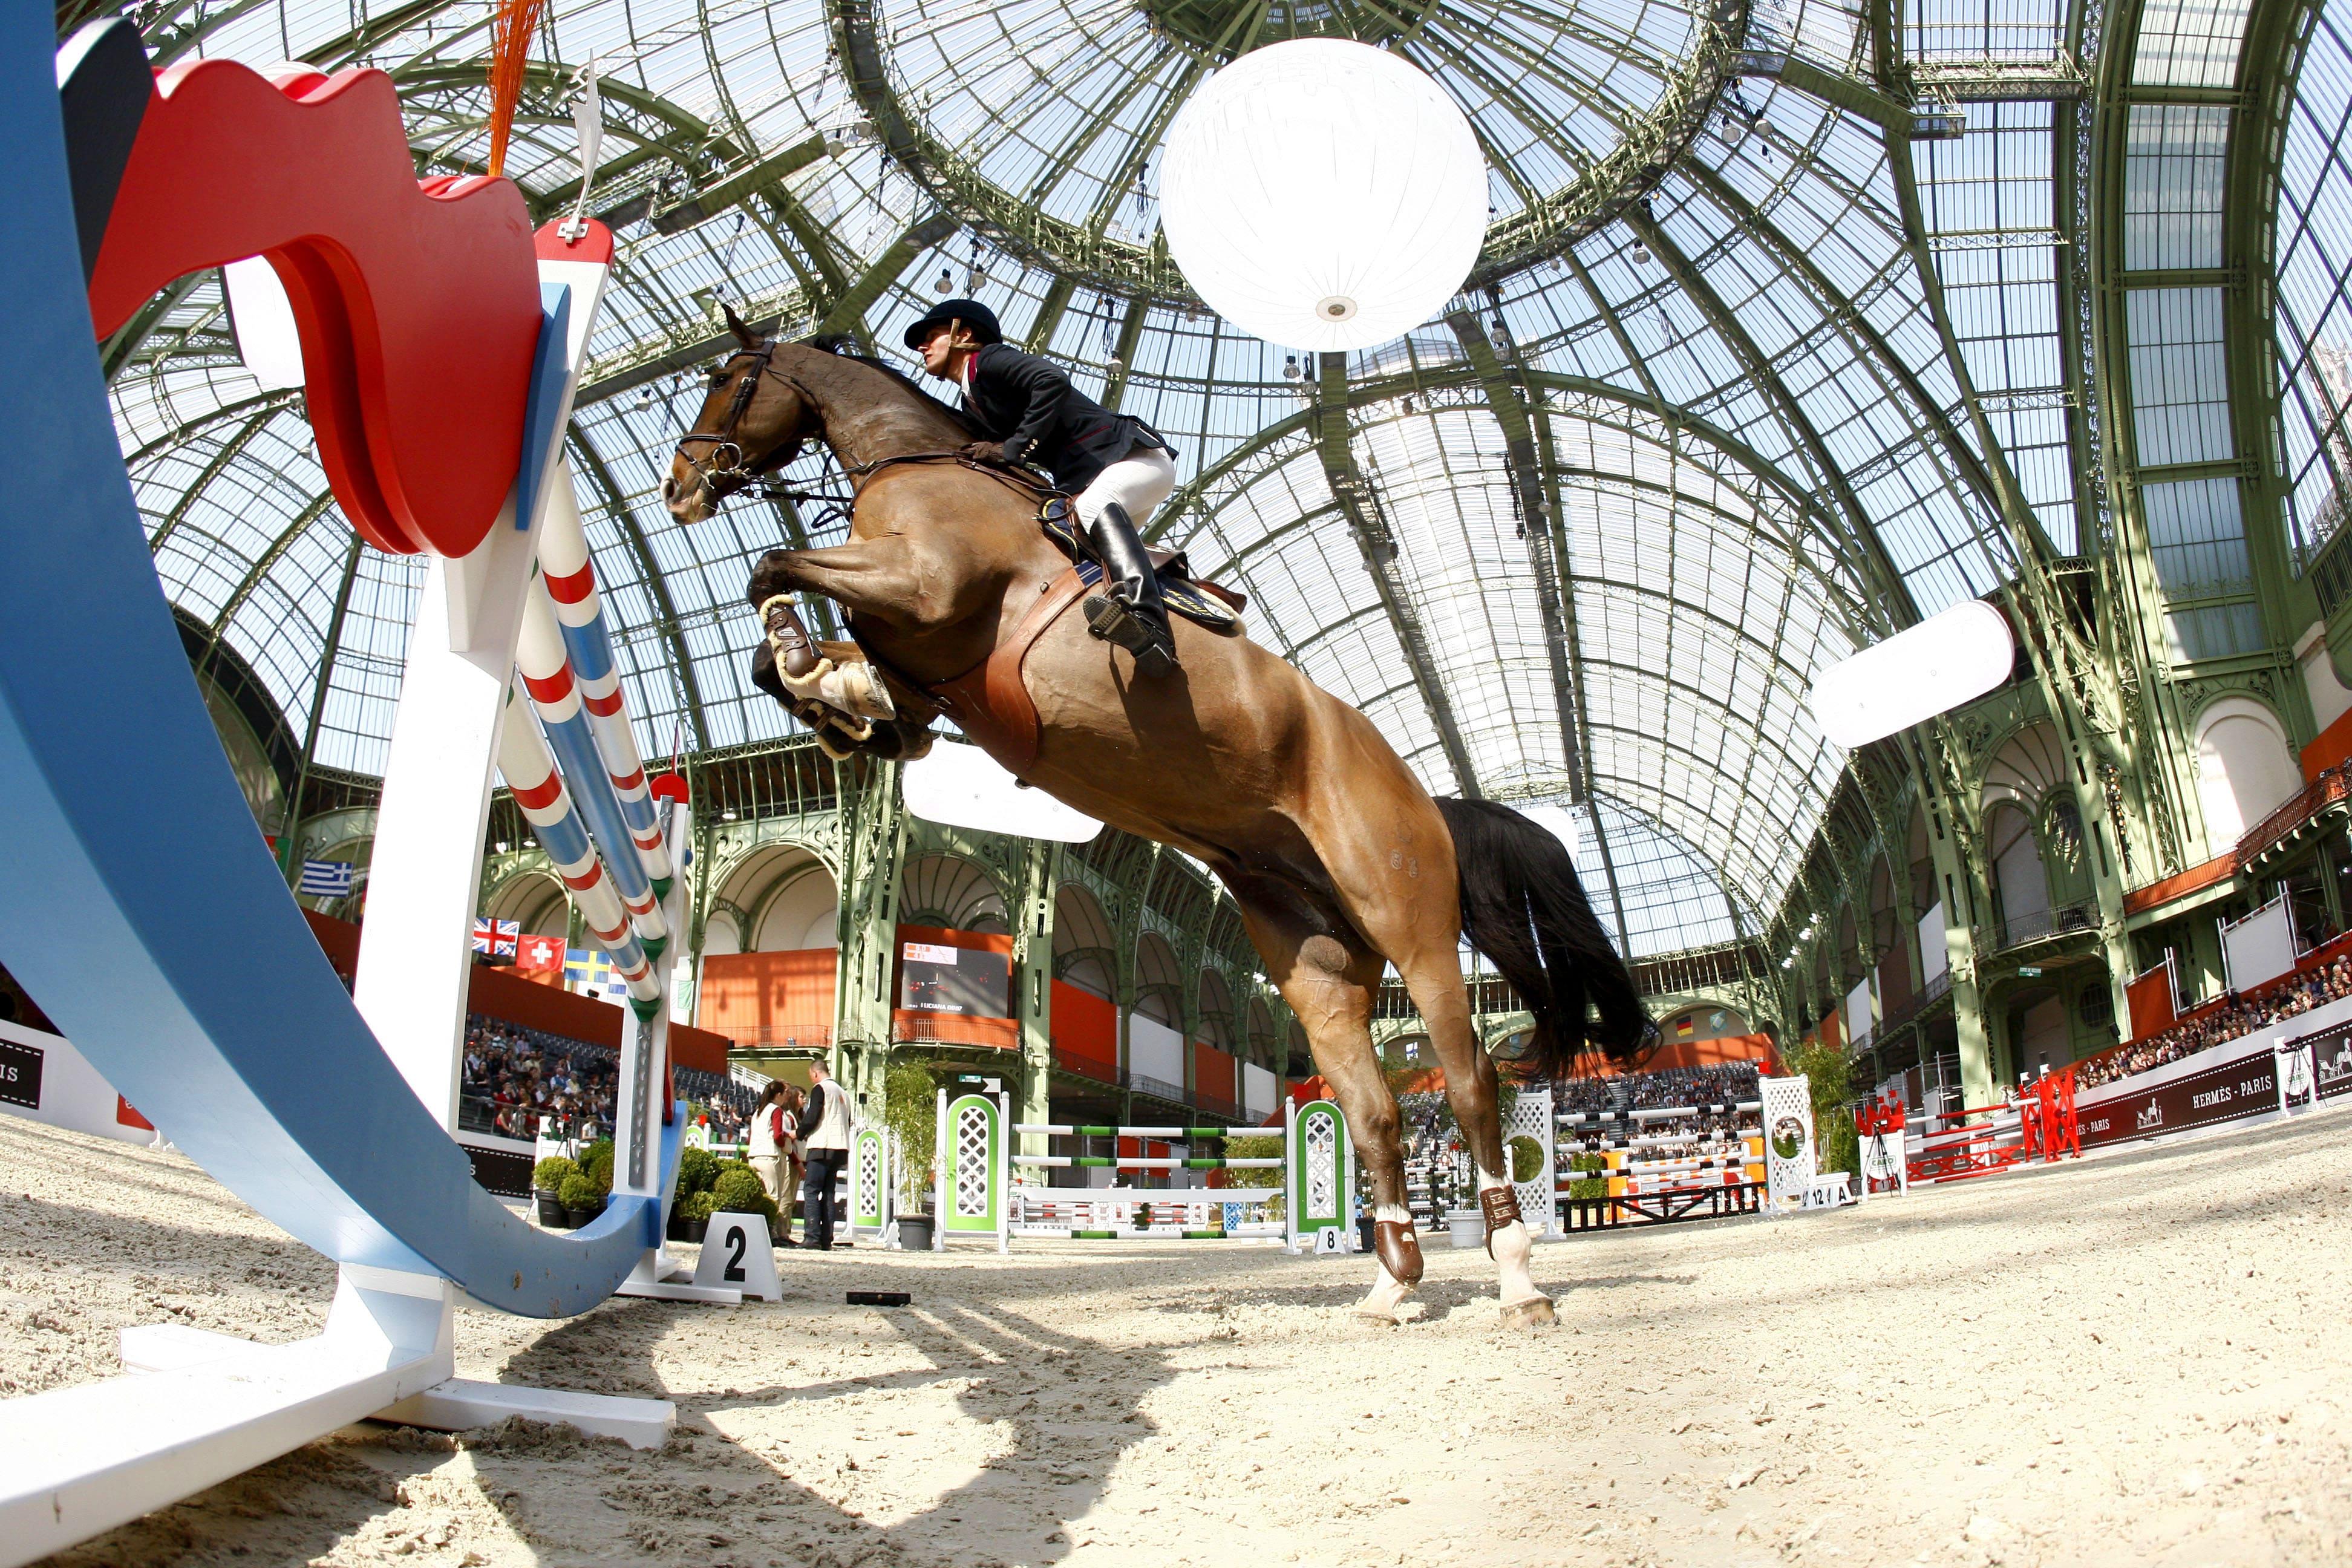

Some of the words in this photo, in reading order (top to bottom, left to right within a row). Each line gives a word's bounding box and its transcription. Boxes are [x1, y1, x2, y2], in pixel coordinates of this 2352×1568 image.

[2192, 1085, 2232, 1109] HERMÈS
[2240, 1075, 2272, 1097] PARIS
[2090, 1118, 2110, 1133] PARIS
[1812, 1189, 1824, 1205] 12
[1838, 1186, 1847, 1201] A
[1327, 1230, 1335, 1249] 8
[724, 1226, 746, 1282] 2
